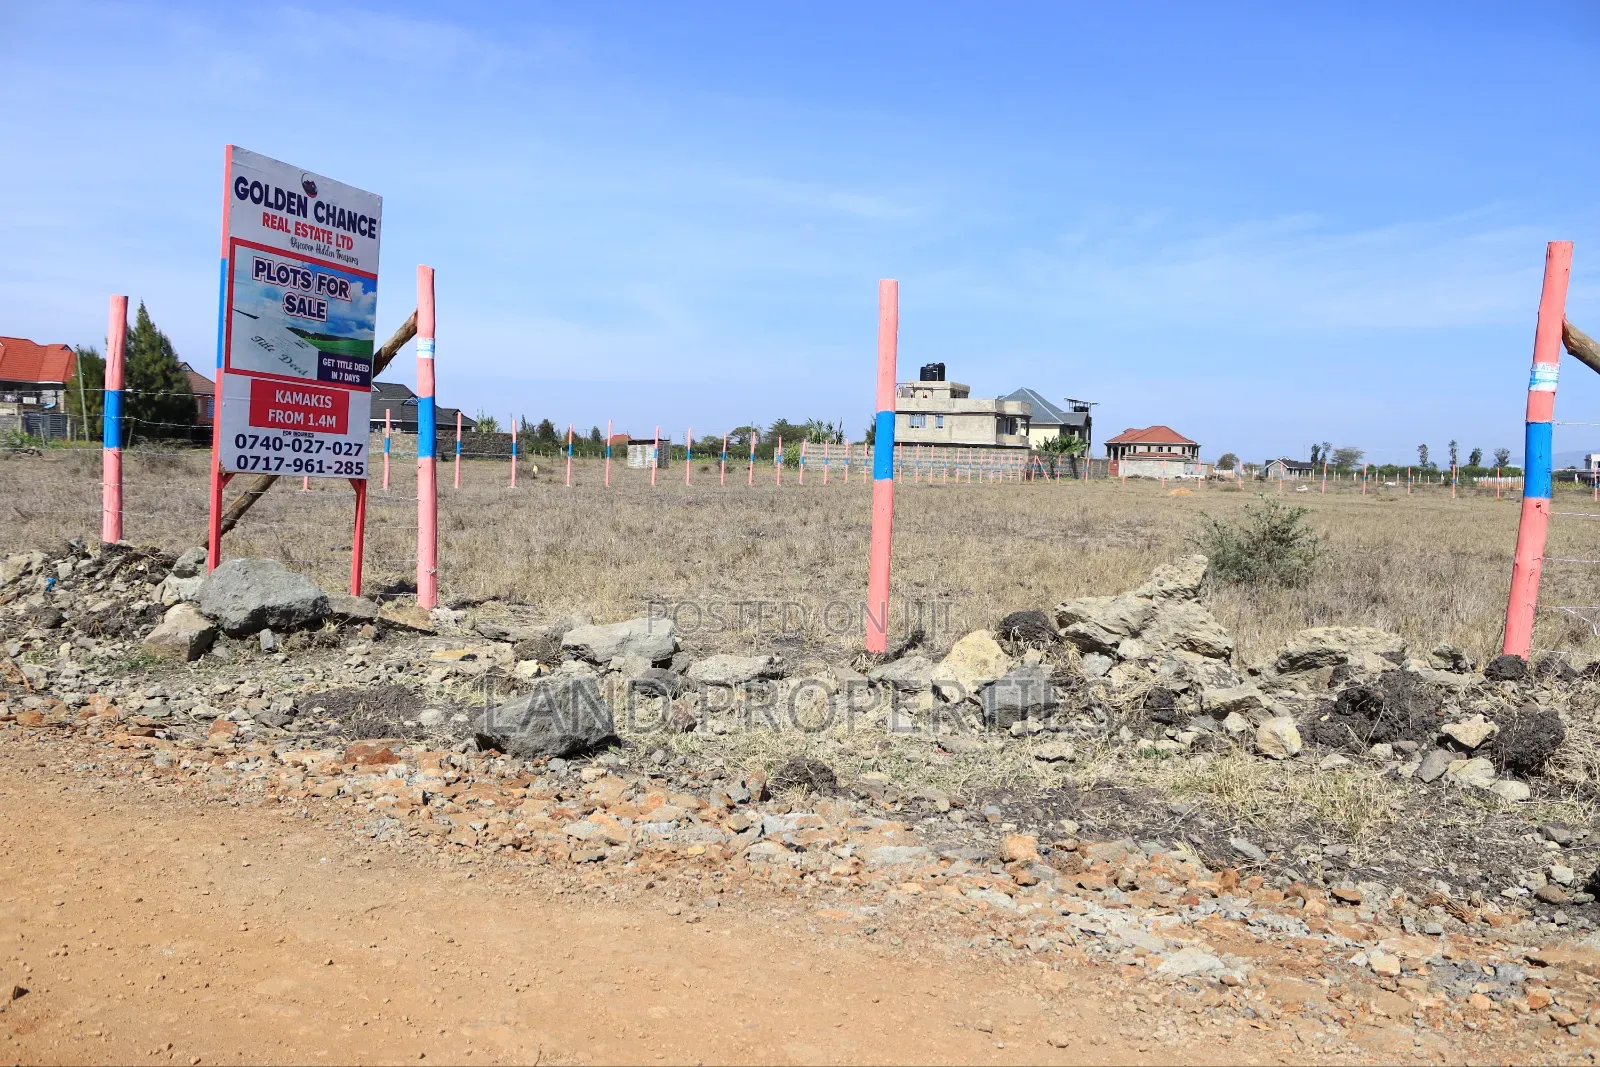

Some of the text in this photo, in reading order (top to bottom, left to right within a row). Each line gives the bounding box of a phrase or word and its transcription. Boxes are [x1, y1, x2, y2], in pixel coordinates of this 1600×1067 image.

[234, 176, 377, 239] GOLDEN CHANCE
[262, 211, 354, 251] REAL ESTATE LTD
[253, 257, 352, 302] PLOTS FOR
[283, 292, 328, 322] SALE
[322, 357, 370, 373] GET TITLE DEED
[331, 370, 360, 383] IN 7 DAYS
[275, 389, 333, 409] KAMAKIS
[268, 409, 336, 428] FROM 1.4M
[234, 433, 364, 457] 0740-027-027
[236, 454, 364, 476] 0717-961-285
